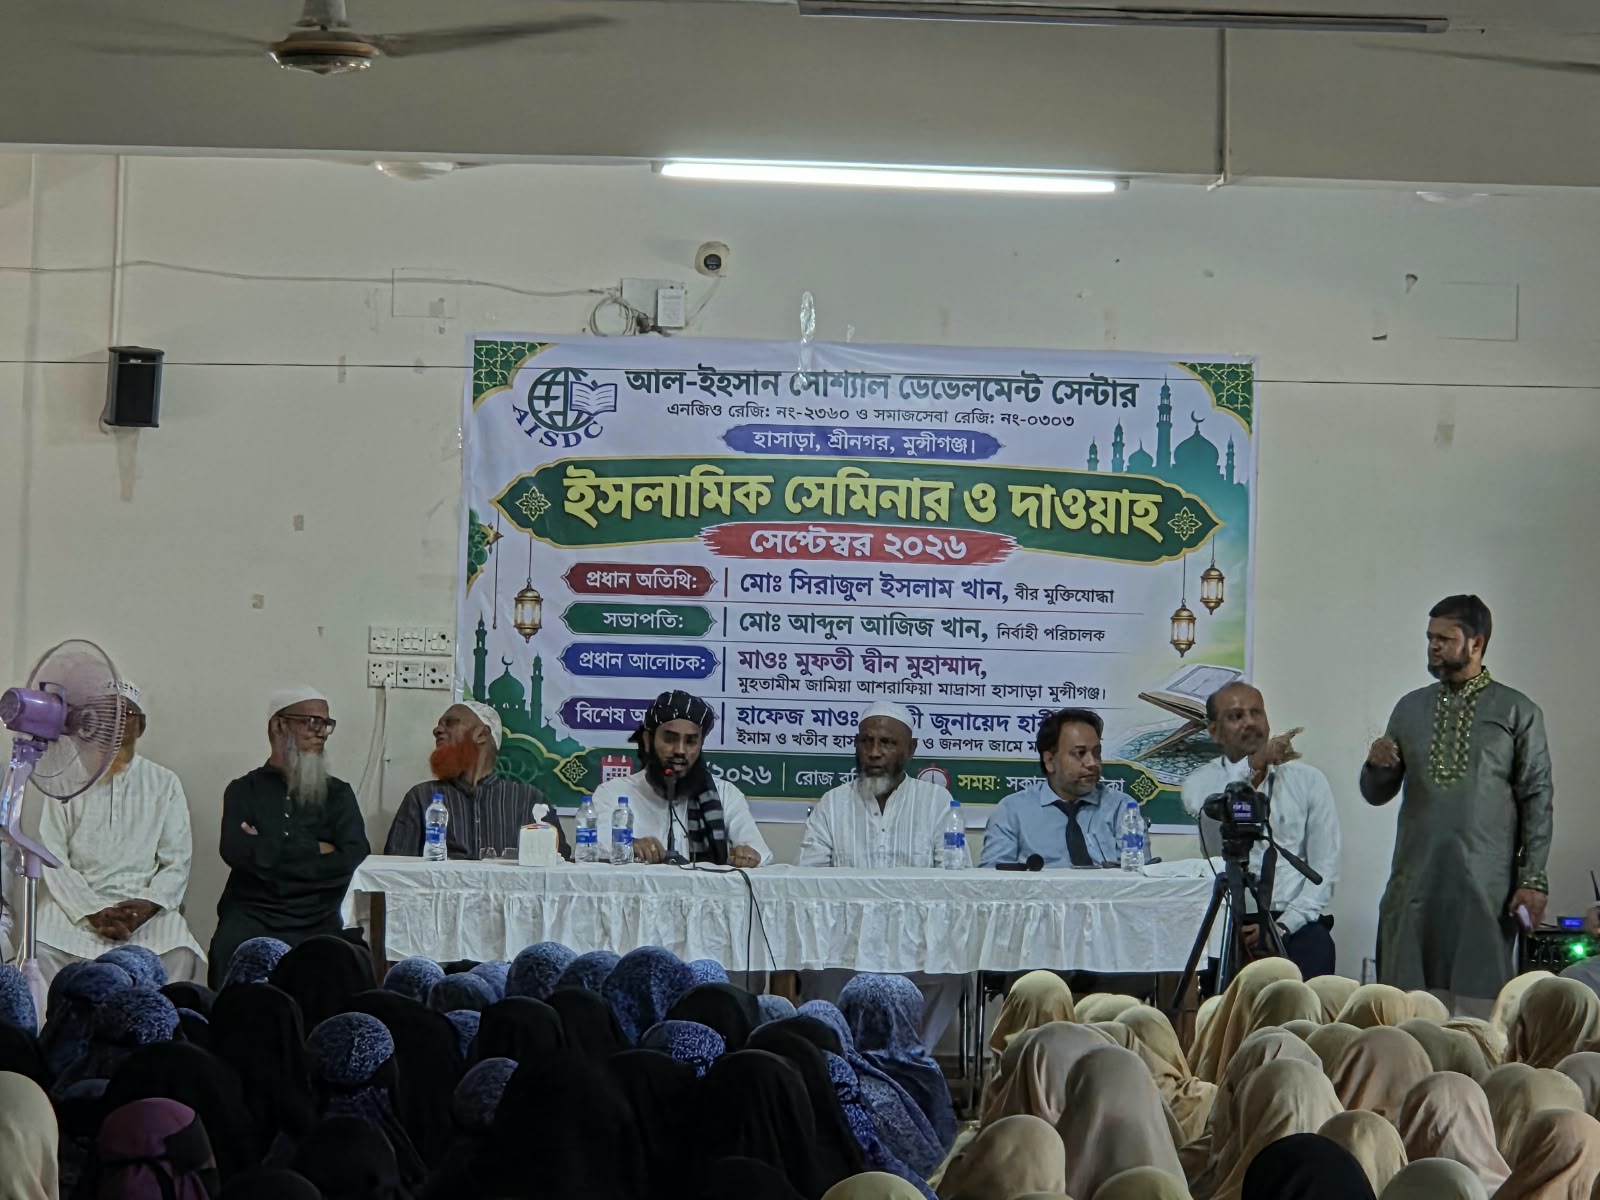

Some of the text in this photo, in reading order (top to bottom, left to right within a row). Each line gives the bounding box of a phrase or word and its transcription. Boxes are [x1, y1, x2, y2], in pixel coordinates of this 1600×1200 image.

[624, 363, 1140, 408] আল-ইহসান সোশ্যাল ডেভেলমেন্ট সেন্টার
[513, 404, 604, 448] AISDC
[667, 400, 722, 418] এনজিও
[775, 405, 850, 421] নং-২৩৬০
[856, 408, 868, 421] ও
[874, 408, 948, 424] সমাজসেবা
[1000, 411, 1075, 428] নং-০৩০৩
[753, 431, 821, 452] হাসাড়া,
[827, 428, 895, 455] শ্রীনগর,
[562, 464, 1164, 544] ইসলামিক সেমিনার ও দাওয়াহ
[750, 525, 967, 561] সেপ্টেম্বর ২০২৬
[586, 567, 698, 591] প্রধান অতিথি:
[740, 567, 1115, 605] মোঃ সিরাজুল ইসলাম খান, বীর মুক্তিযোদ্ধা
[602, 608, 684, 629] সভাপতি:
[739, 610, 1106, 643] মোঃ আব্দুল আজিজ খান, নির্বাহী পরিচালক
[579, 650, 706, 672] প্রধান আলোচক:
[738, 646, 987, 681] মাওঃ মুফতী দ্বীন মুহাম্মাদ,
[737, 673, 800, 694] মুহতামীম
[805, 675, 852, 694] জামিয়া
[857, 677, 932, 696] আশরাফিয়া
[938, 681, 987, 698] মাদ্রাসা
[991, 684, 1043, 702] হাসাড়া
[575, 701, 626, 725] বিশেষ
[736, 705, 805, 726] হাফেজ
[811, 707, 859, 727] মাওঃ
[929, 711, 1012, 736] জুনায়েদ
[736, 726, 771, 746] ইমাম
[776, 732, 787, 746] ও
[792, 729, 829, 748] খতীব
[922, 737, 935, 750] ও
[939, 738, 984, 752] জনপদ
[988, 738, 1024, 753] জামে
[795, 769, 835, 786] রোজ
[958, 774, 1000, 791] সময়:
